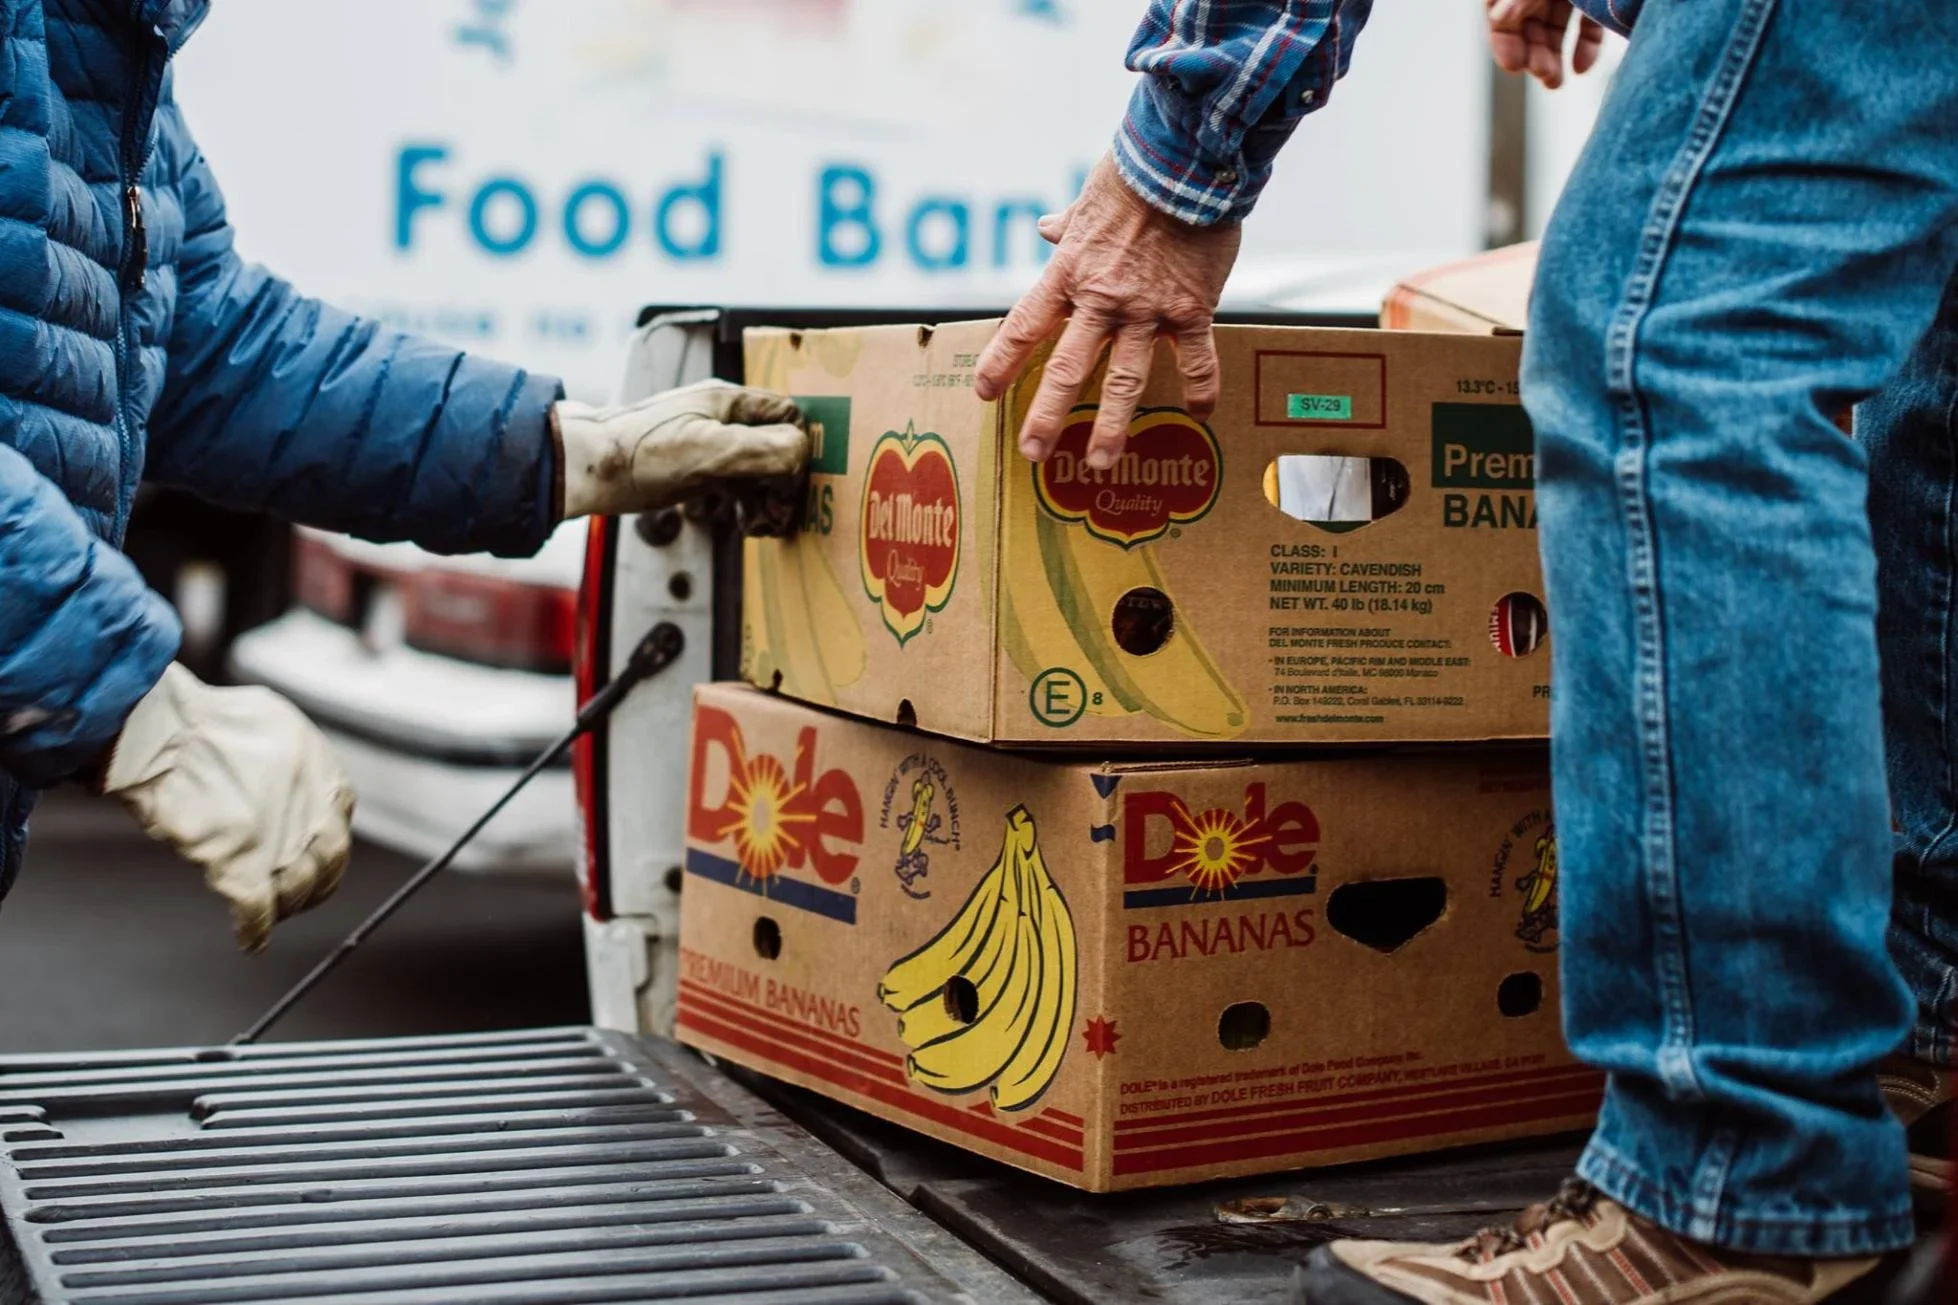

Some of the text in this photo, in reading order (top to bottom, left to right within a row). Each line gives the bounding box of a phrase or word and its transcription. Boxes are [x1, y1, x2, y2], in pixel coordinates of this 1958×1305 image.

[392, 144, 1094, 272] Food Ban
[1301, 397, 1342, 413] SV-29
[1110, 451, 1210, 488] Monte
[1444, 443, 1539, 480] Prem
[869, 490, 893, 541] Del
[895, 493, 955, 548] Monte
[1095, 489, 1164, 518] Quality
[1270, 544, 1326, 558] CLASS:
[886, 549, 925, 592] Quality
[1270, 561, 1422, 577] VARIETY: CAVENDISH
[1269, 579, 1446, 595] MINIMUM LENGTH: 20 cm
[1269, 597, 1433, 615] NET WT. 40 lb (18.14 kg)
[1268, 638, 1288, 648] DEL
[1290, 638, 1325, 648] MONTE
[1326, 639, 1358, 649] FRESH
[1359, 639, 1405, 649] PRODUCE
[1269, 627, 1392, 638] FOR INFORMATION ABOUT
[1274, 656, 1285, 666] IN
[1386, 657, 1408, 666] AND
[1092, 692, 1104, 706] 8
[1273, 685, 1368, 695] IN NORTH AMERICA:
[687, 703, 865, 886] Dole
[1123, 781, 1321, 890] Dole
[1126, 908, 1316, 963] BANANAS
[681, 947, 862, 1039] PREMIUM BANANAS
[1158, 1079, 1169, 1091] is
[1179, 1072, 1233, 1089] registered
[1235, 1065, 1286, 1082] trademark
[1288, 1064, 1300, 1076] of
[1301, 1061, 1325, 1075] Dole
[1327, 1058, 1353, 1071] Food
[1120, 1096, 1193, 1116] DISTRIBUTED
[1194, 1094, 1211, 1107] BY
[1211, 1087, 1248, 1105] DOLE
[1251, 1081, 1295, 1100] FRESH
[1297, 1076, 1337, 1093] FRUIT
